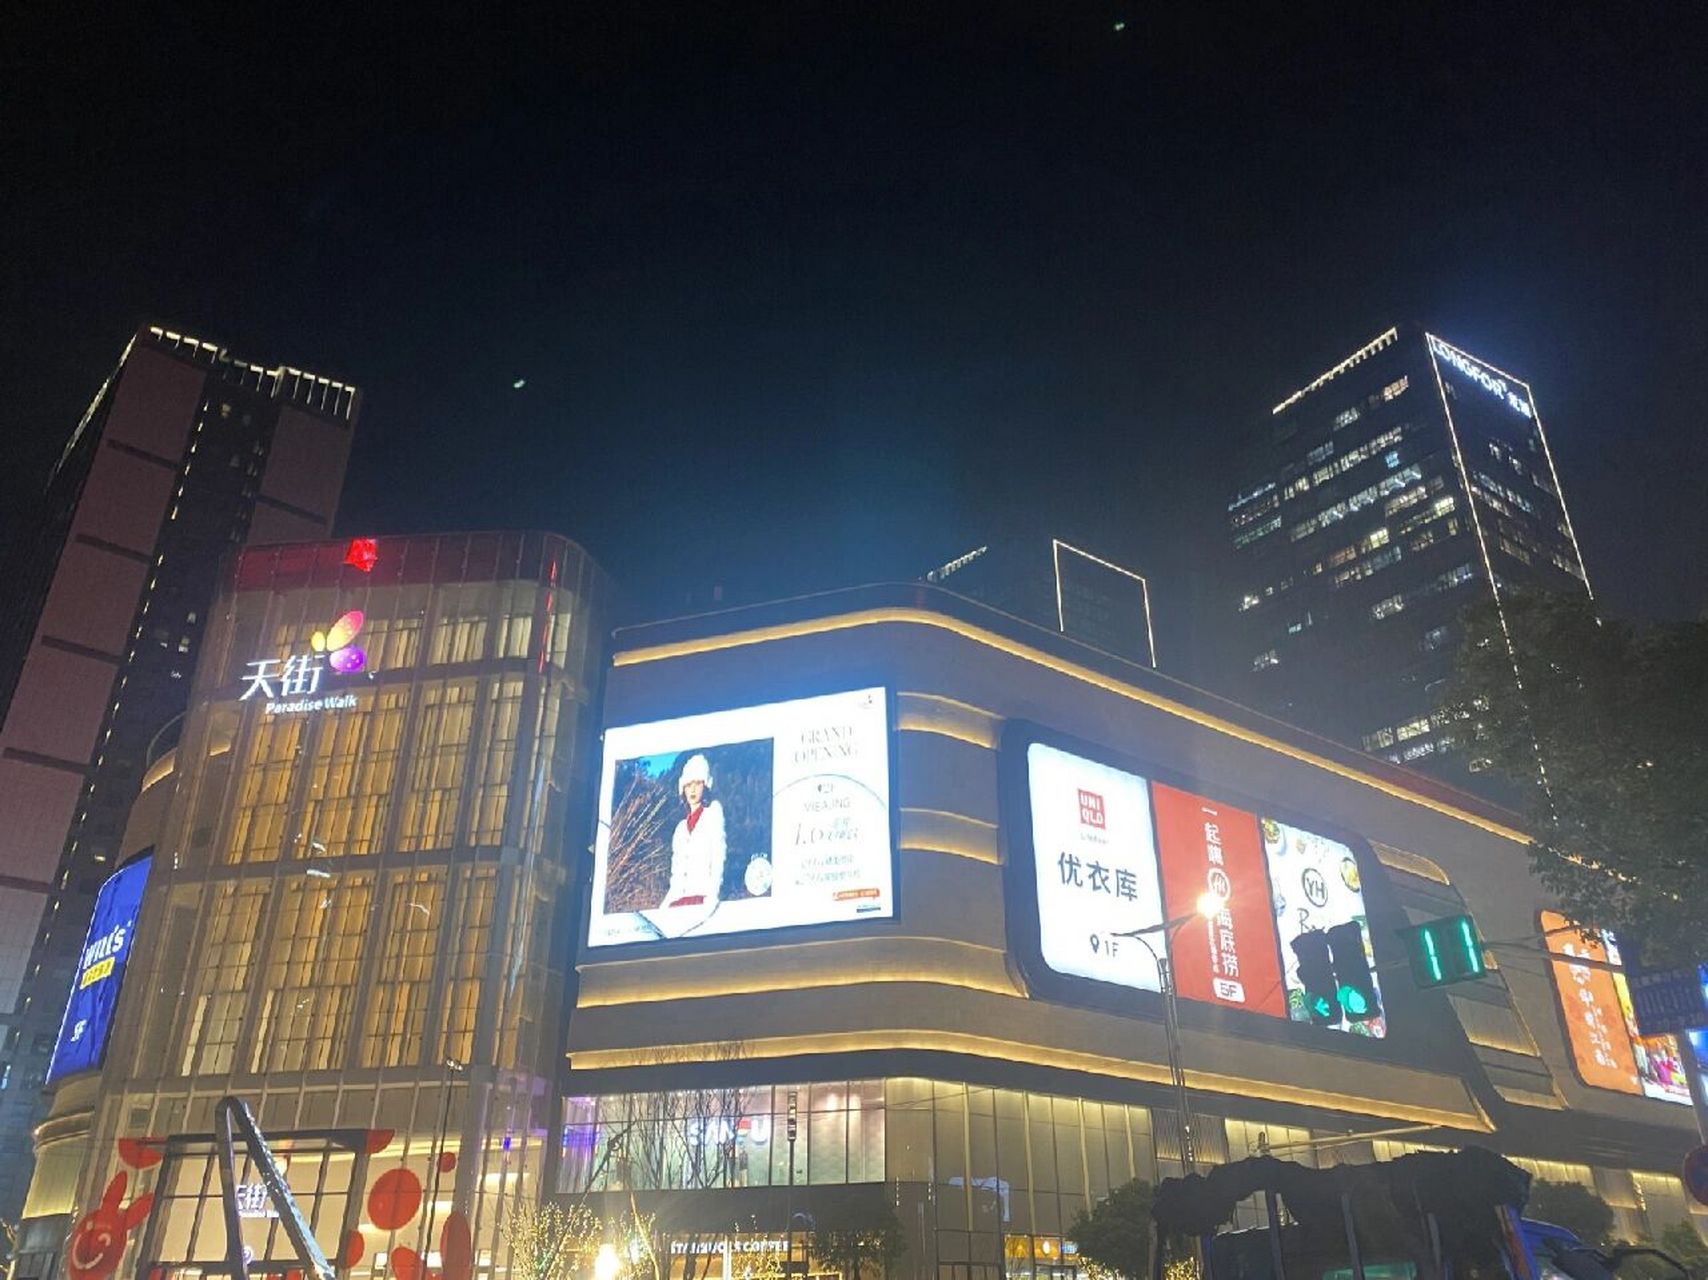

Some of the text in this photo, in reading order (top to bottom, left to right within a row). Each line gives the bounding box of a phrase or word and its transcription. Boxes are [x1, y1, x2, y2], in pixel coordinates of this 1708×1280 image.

[238, 655, 326, 701] 天街
[265, 695, 358, 714] Paradise Walk
[1080, 792, 1103, 811] UNI
[1081, 810, 1104, 828] QLO
[1057, 851, 1139, 901] 优衣库
[1305, 878, 1326, 900] YH
[1104, 940, 1119, 957] 1F
[671, 1240, 742, 1254] STARBUCS
